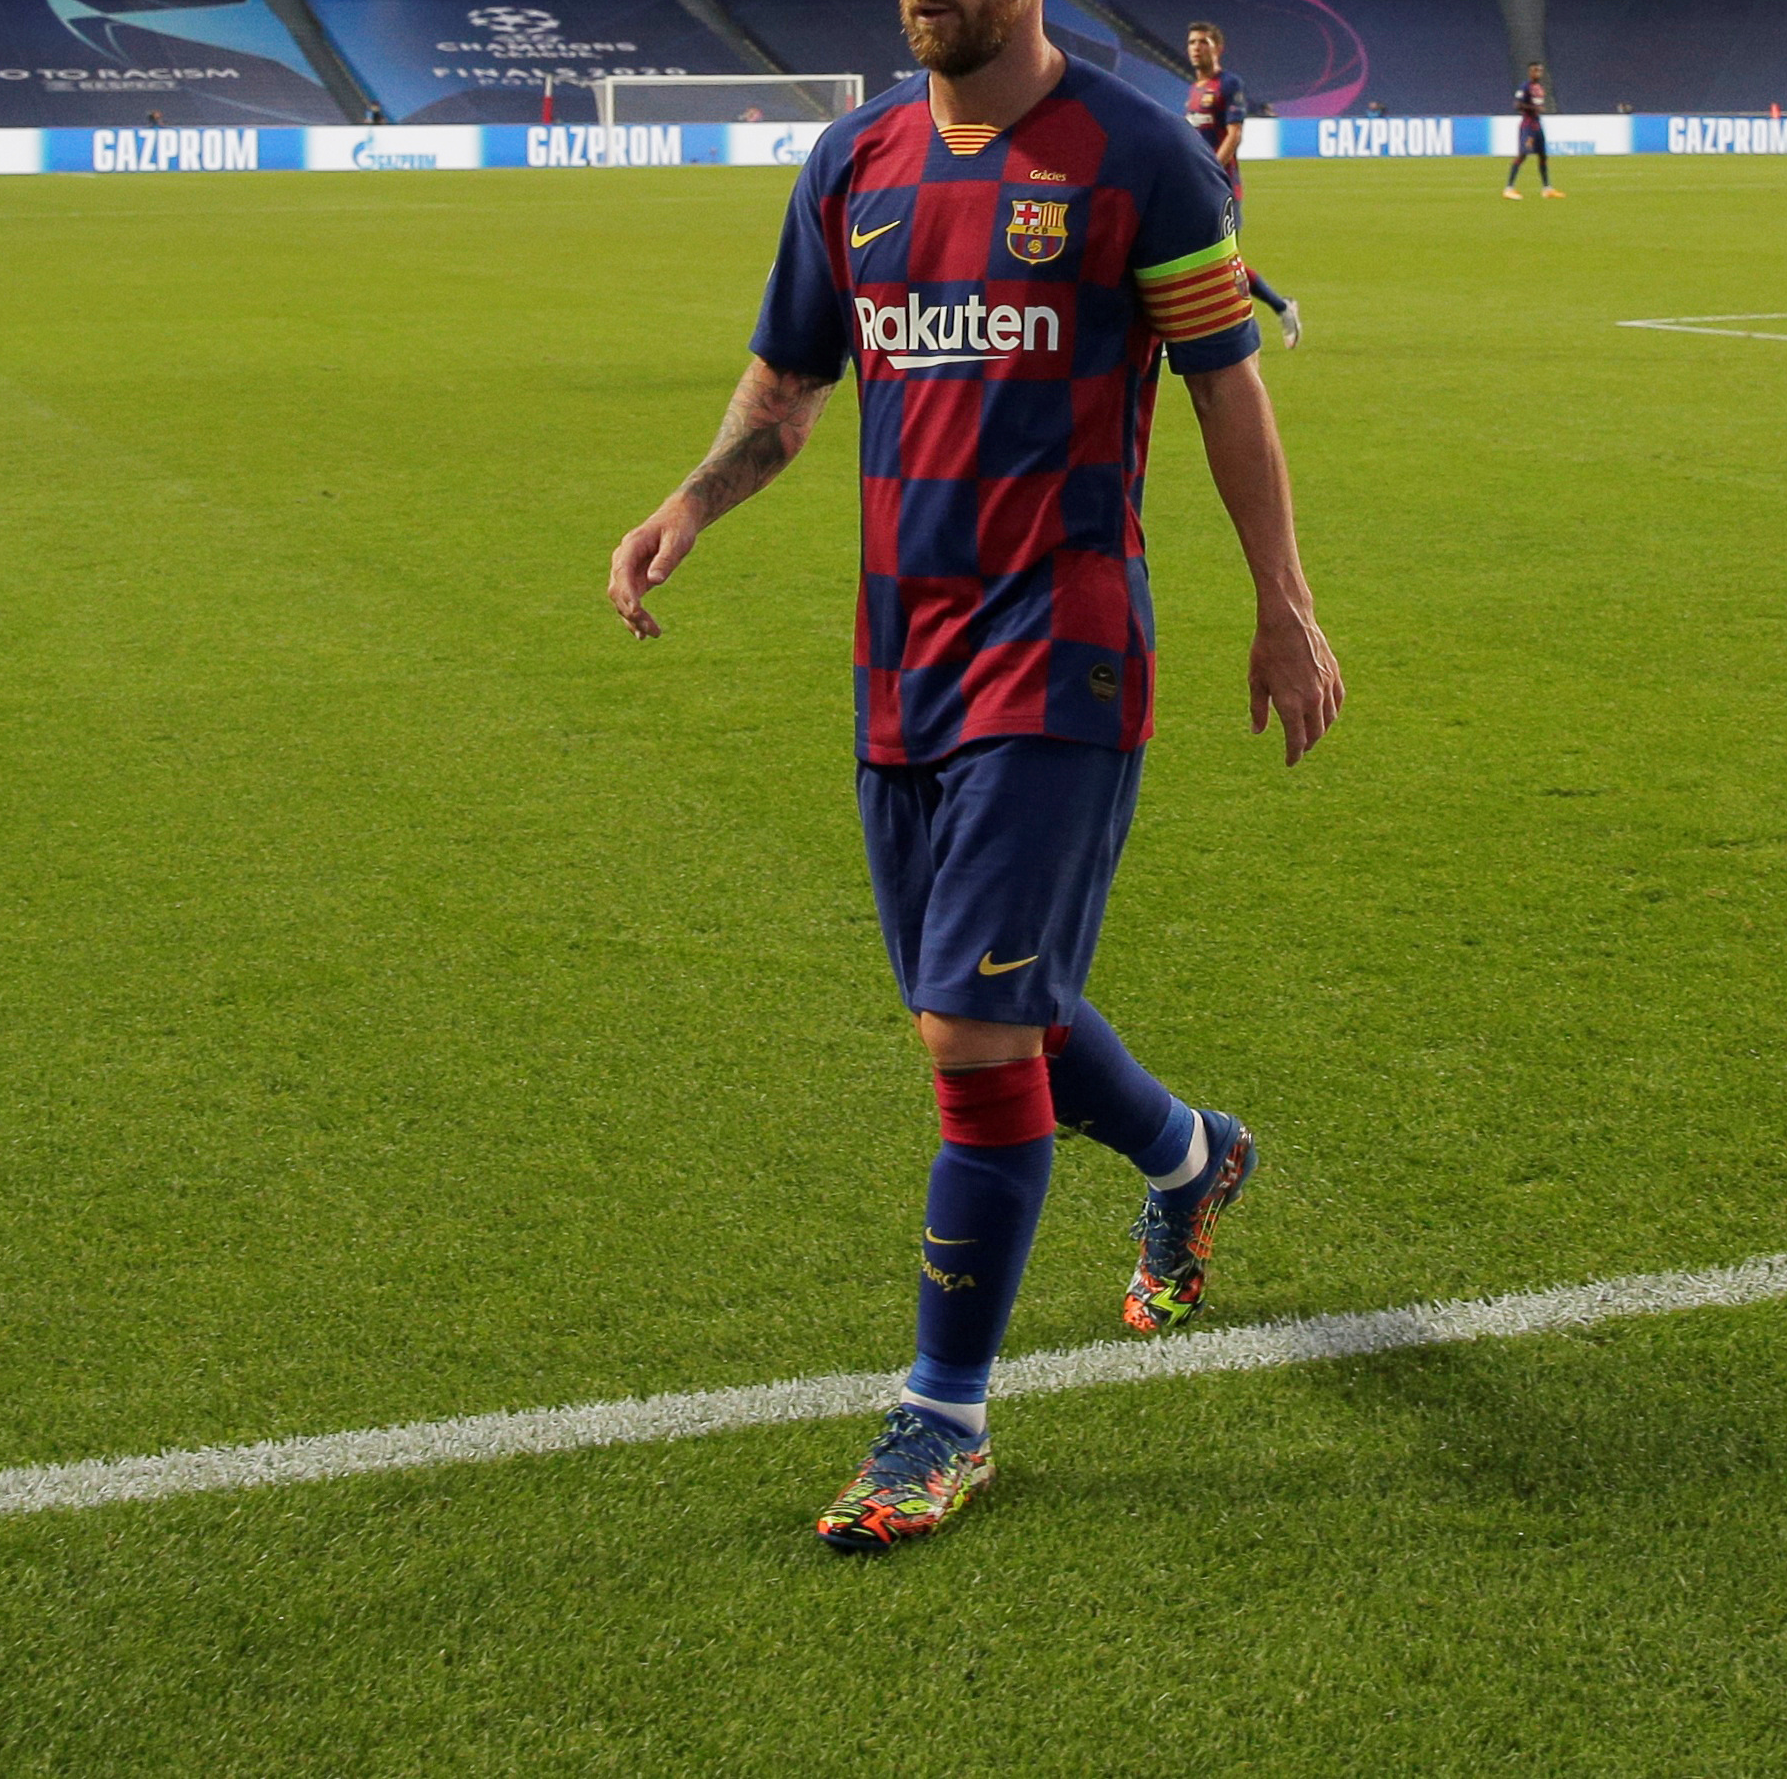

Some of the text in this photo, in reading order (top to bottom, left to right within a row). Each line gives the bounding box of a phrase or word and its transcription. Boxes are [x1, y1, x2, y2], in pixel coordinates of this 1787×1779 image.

[36, 68, 89, 80] TO
[97, 67, 241, 80] RACISM
[92, 128, 258, 171] GAZPROM
[526, 125, 682, 167] GAZPROM
[1318, 118, 1454, 157] GAZPROM
[1025, 226, 1049, 235] FCB
[854, 292, 1060, 352] Rakuten
[921, 1251, 976, 1291] ARÇA
